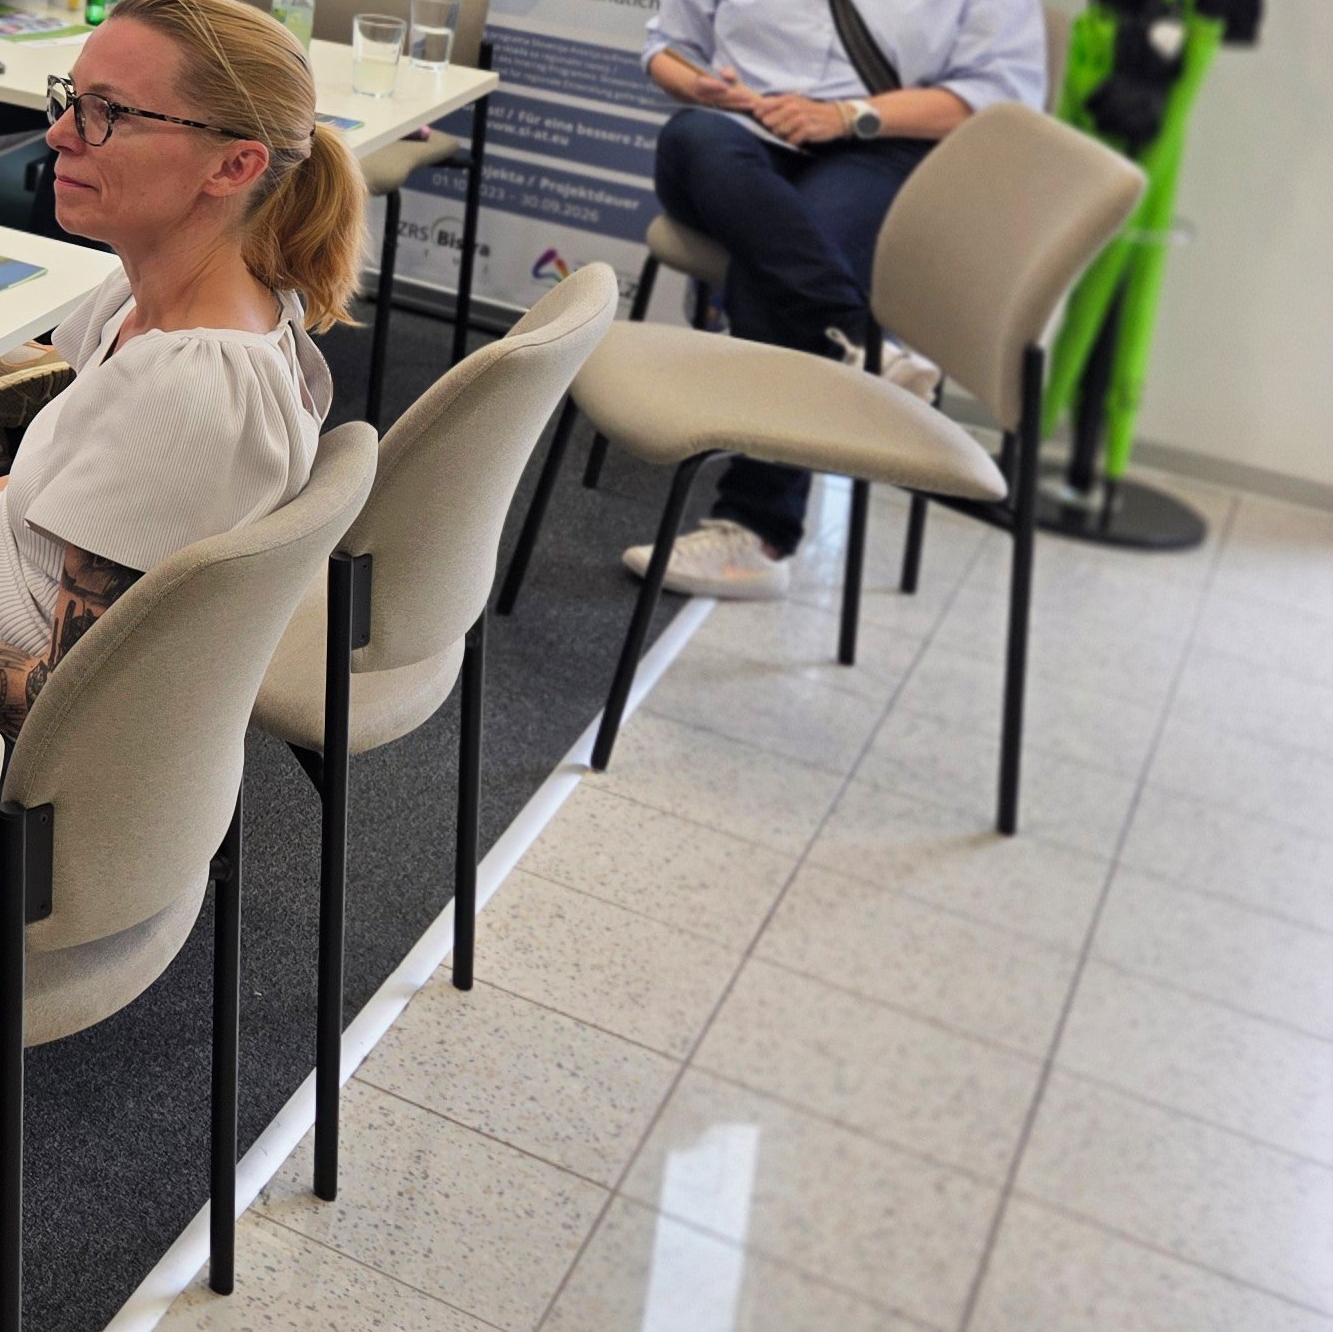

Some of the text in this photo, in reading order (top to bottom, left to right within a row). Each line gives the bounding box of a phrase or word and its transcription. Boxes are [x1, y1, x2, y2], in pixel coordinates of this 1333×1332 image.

[518, 109, 542, 125] Für
[544, 116, 574, 133] eine
[576, 121, 631, 146] bessere
[433, 172, 505, 202] 01.10023
[539, 177, 640, 209] Projektdauer
